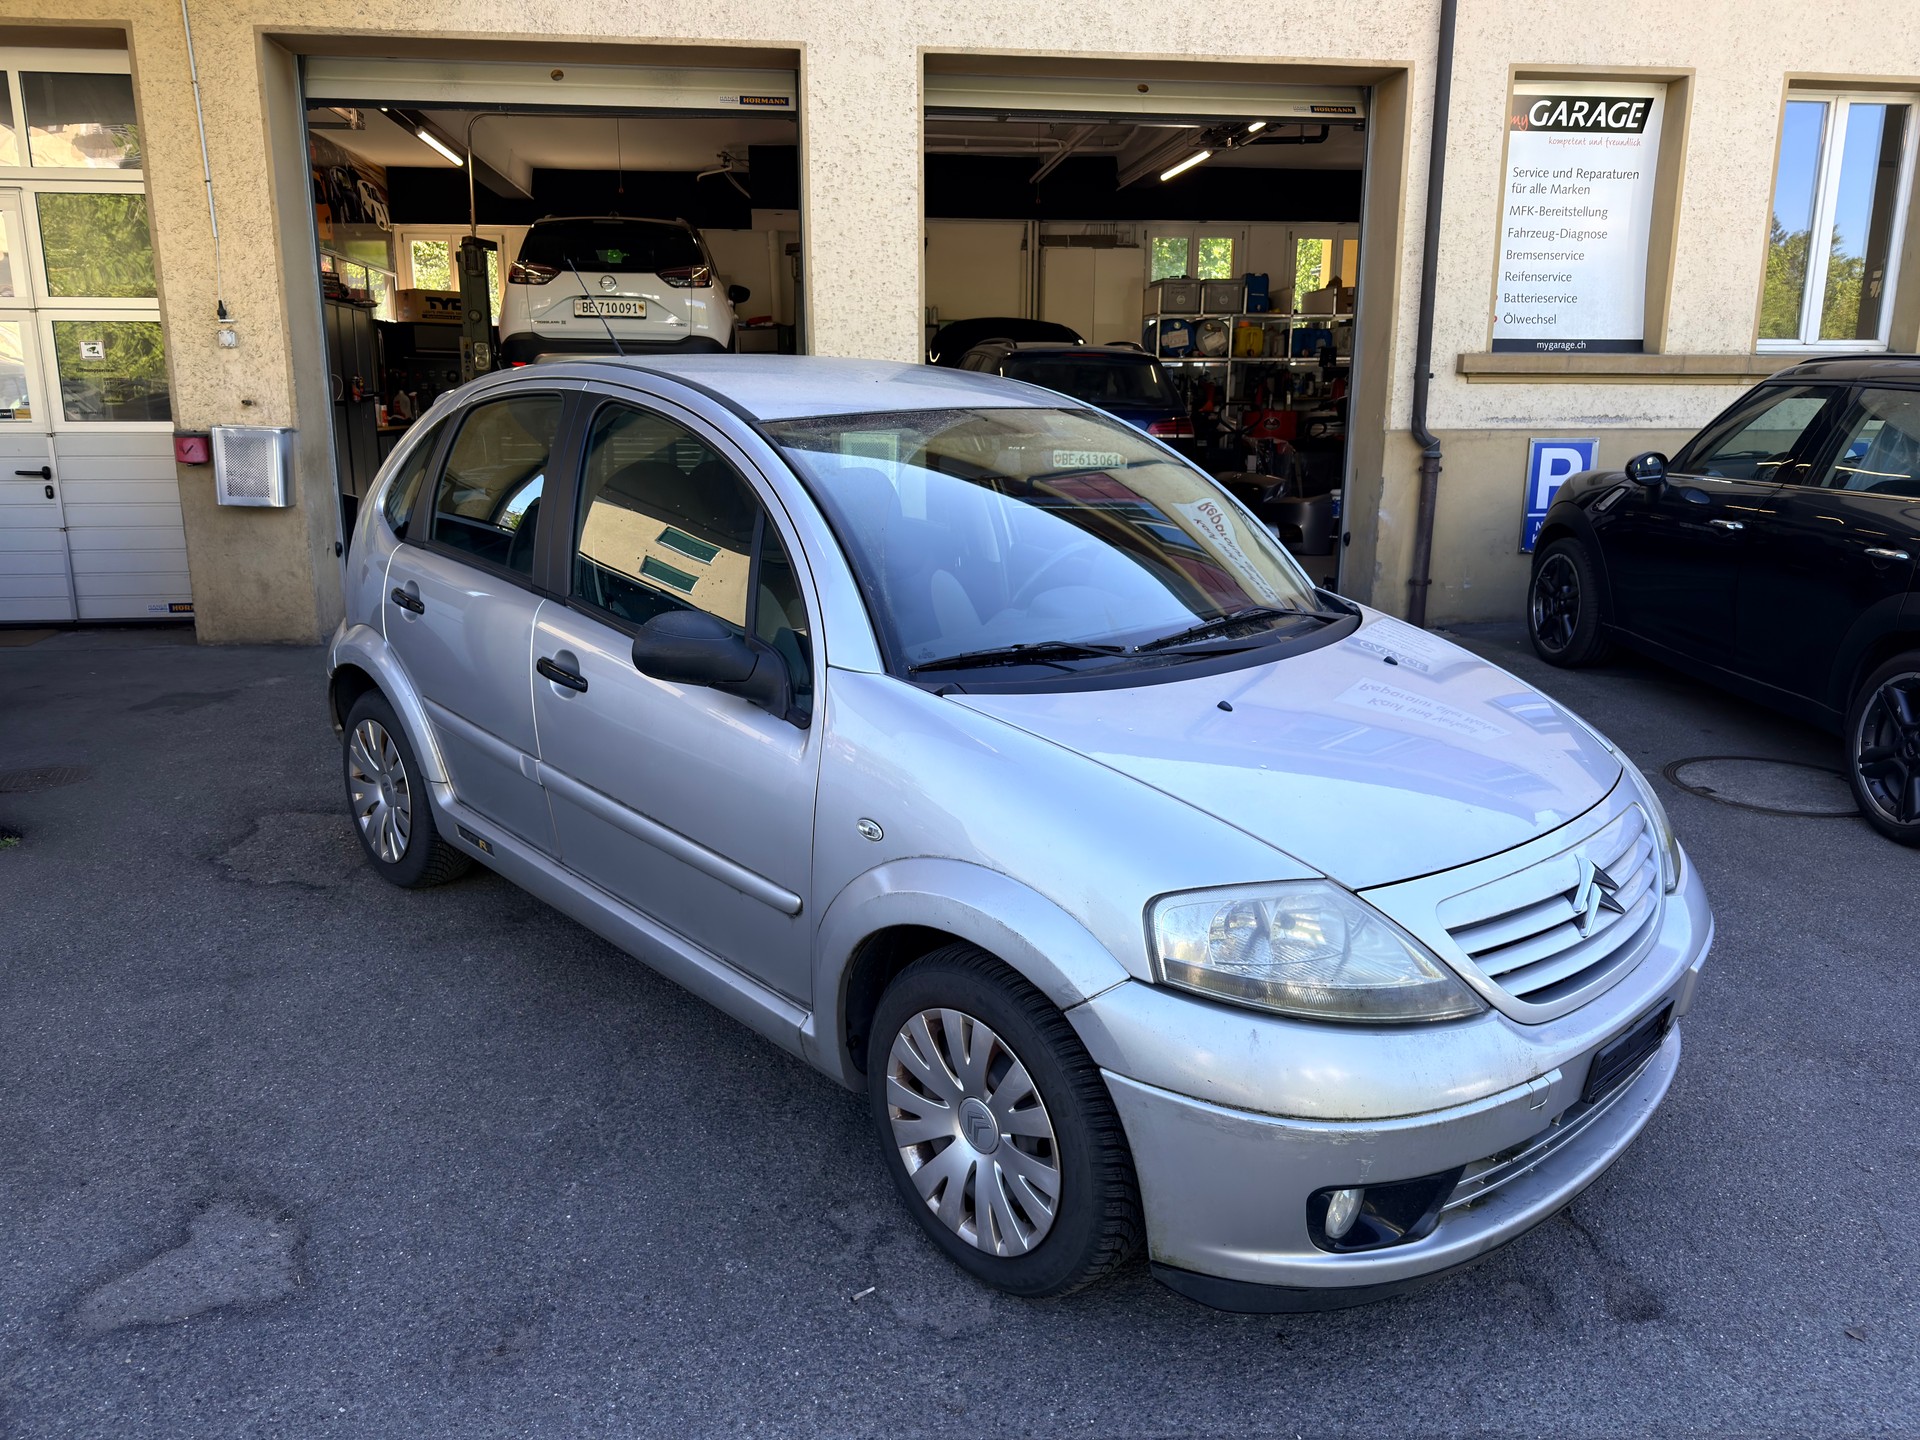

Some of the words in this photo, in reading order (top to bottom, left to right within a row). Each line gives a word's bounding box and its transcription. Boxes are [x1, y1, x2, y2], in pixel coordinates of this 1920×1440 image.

[1548, 137, 1586, 147] kompetent
[1589, 137, 1603, 146] und
[1604, 137, 1641, 148] freundlich
[1512, 167, 1549, 179] Service
[1552, 168, 1573, 179] und
[1576, 168, 1640, 182] Reparaturen
[1511, 182, 1526, 194] für
[1529, 183, 1547, 194] alle
[1550, 184, 1591, 195] Marken
[1509, 205, 1608, 220] MFK-Bereitstellung
[1508, 227, 1608, 242] Fahrzeug-Diagnose
[1506, 249, 1585, 261] Bremsenservice
[1504, 271, 1572, 282] Reifenservice
[1503, 292, 1578, 303] Batterieservice
[598, 302, 638, 314] 710091
[1503, 312, 1557, 325] Ölwechsel
[1536, 341, 1587, 351] mygarage.ch
[1536, 448, 1583, 509] P
